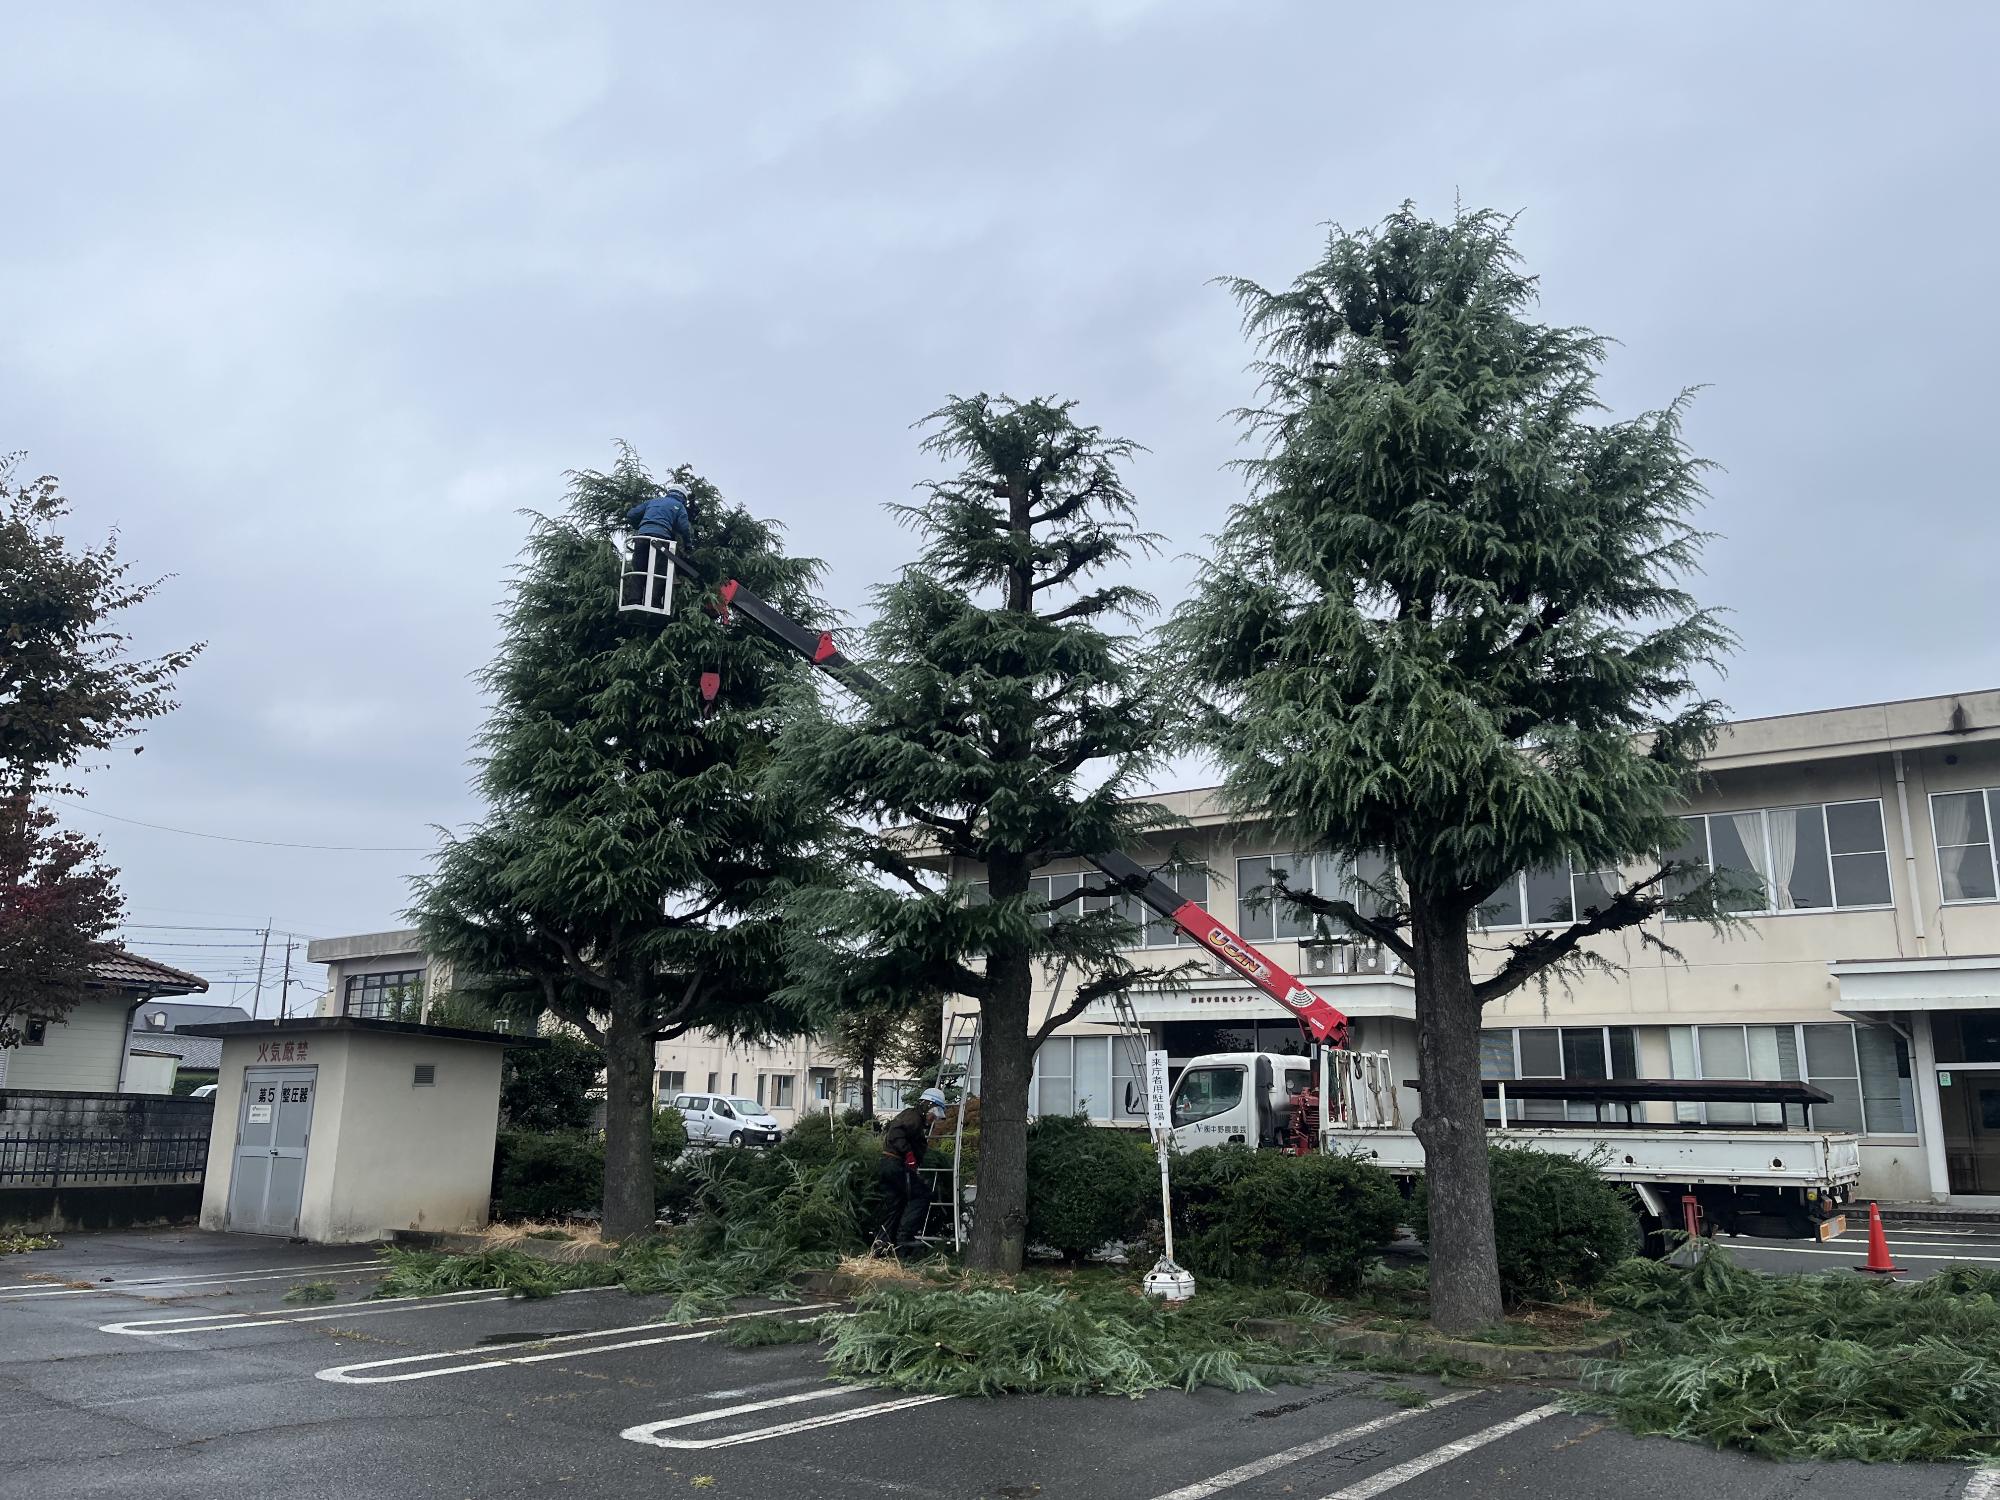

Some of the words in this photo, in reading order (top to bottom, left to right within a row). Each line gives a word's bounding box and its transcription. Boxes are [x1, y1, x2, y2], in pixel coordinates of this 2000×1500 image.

[257, 1040, 309, 1063] 火気厳禁
[1152, 1058, 1165, 1121] 来庁者用駐車場
